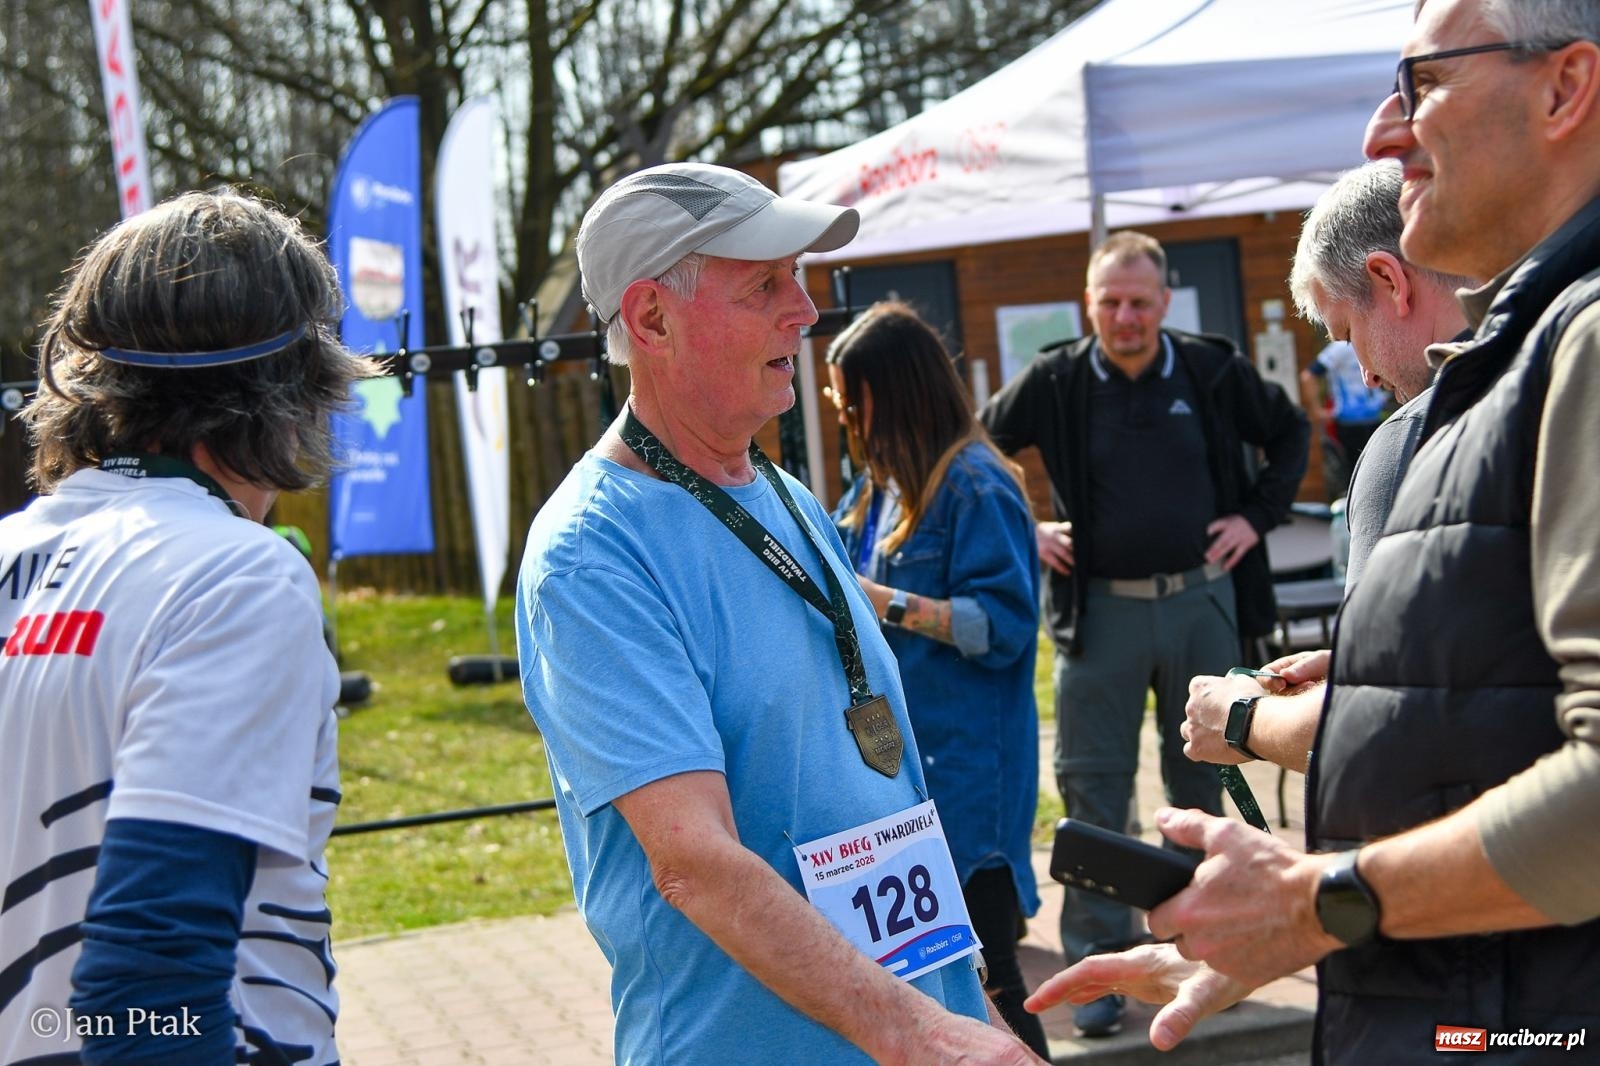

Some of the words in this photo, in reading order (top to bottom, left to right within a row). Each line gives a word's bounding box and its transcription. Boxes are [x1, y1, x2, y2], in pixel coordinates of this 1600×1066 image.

[117, 457, 140, 466] BIEG
[763, 548, 781, 566] BIEG
[763, 534, 807, 582] TWARDZIELA
[778, 565, 794, 579] XIV
[810, 848, 833, 868] XIV
[839, 836, 872, 859] BIEG
[874, 812, 935, 846] TWARDZIELA
[815, 870, 825, 881] 15
[826, 862, 855, 878] marzec
[855, 854, 876, 869] 2026
[851, 864, 939, 943] 128
